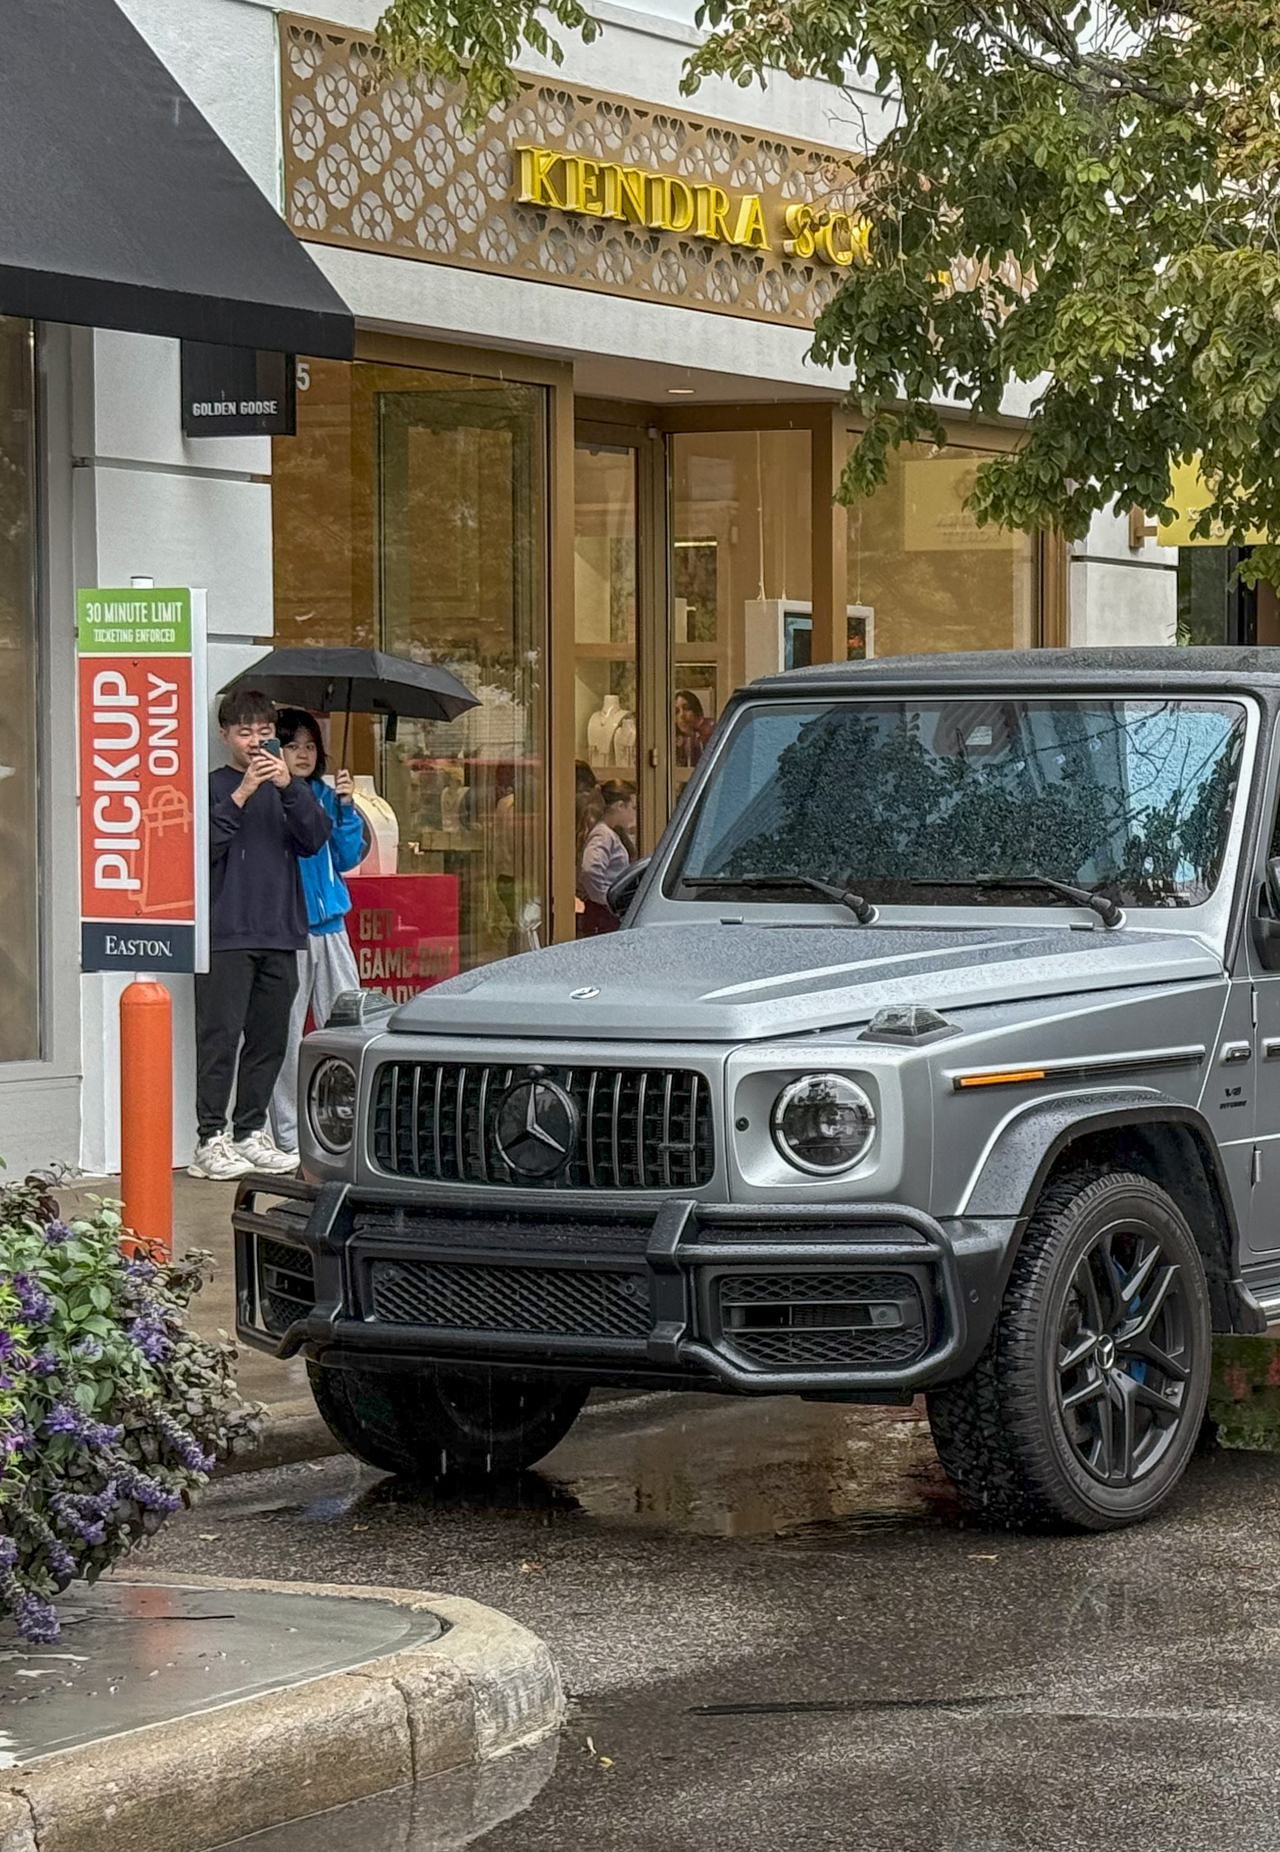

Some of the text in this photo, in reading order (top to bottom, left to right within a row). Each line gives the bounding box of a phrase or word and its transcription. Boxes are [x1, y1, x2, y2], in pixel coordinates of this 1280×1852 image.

[517, 145, 772, 251] KENDRA
[192, 401, 278, 416] GOLDEN GOOSE
[86, 602, 183, 623] 30 MINUTE LIMIT
[93, 628, 176, 643] TICKETING ENFORCED
[147, 672, 180, 777] ONLY
[93, 670, 141, 890] PICKUP
[359, 908, 394, 940] GET
[360, 946, 413, 980] GAME
